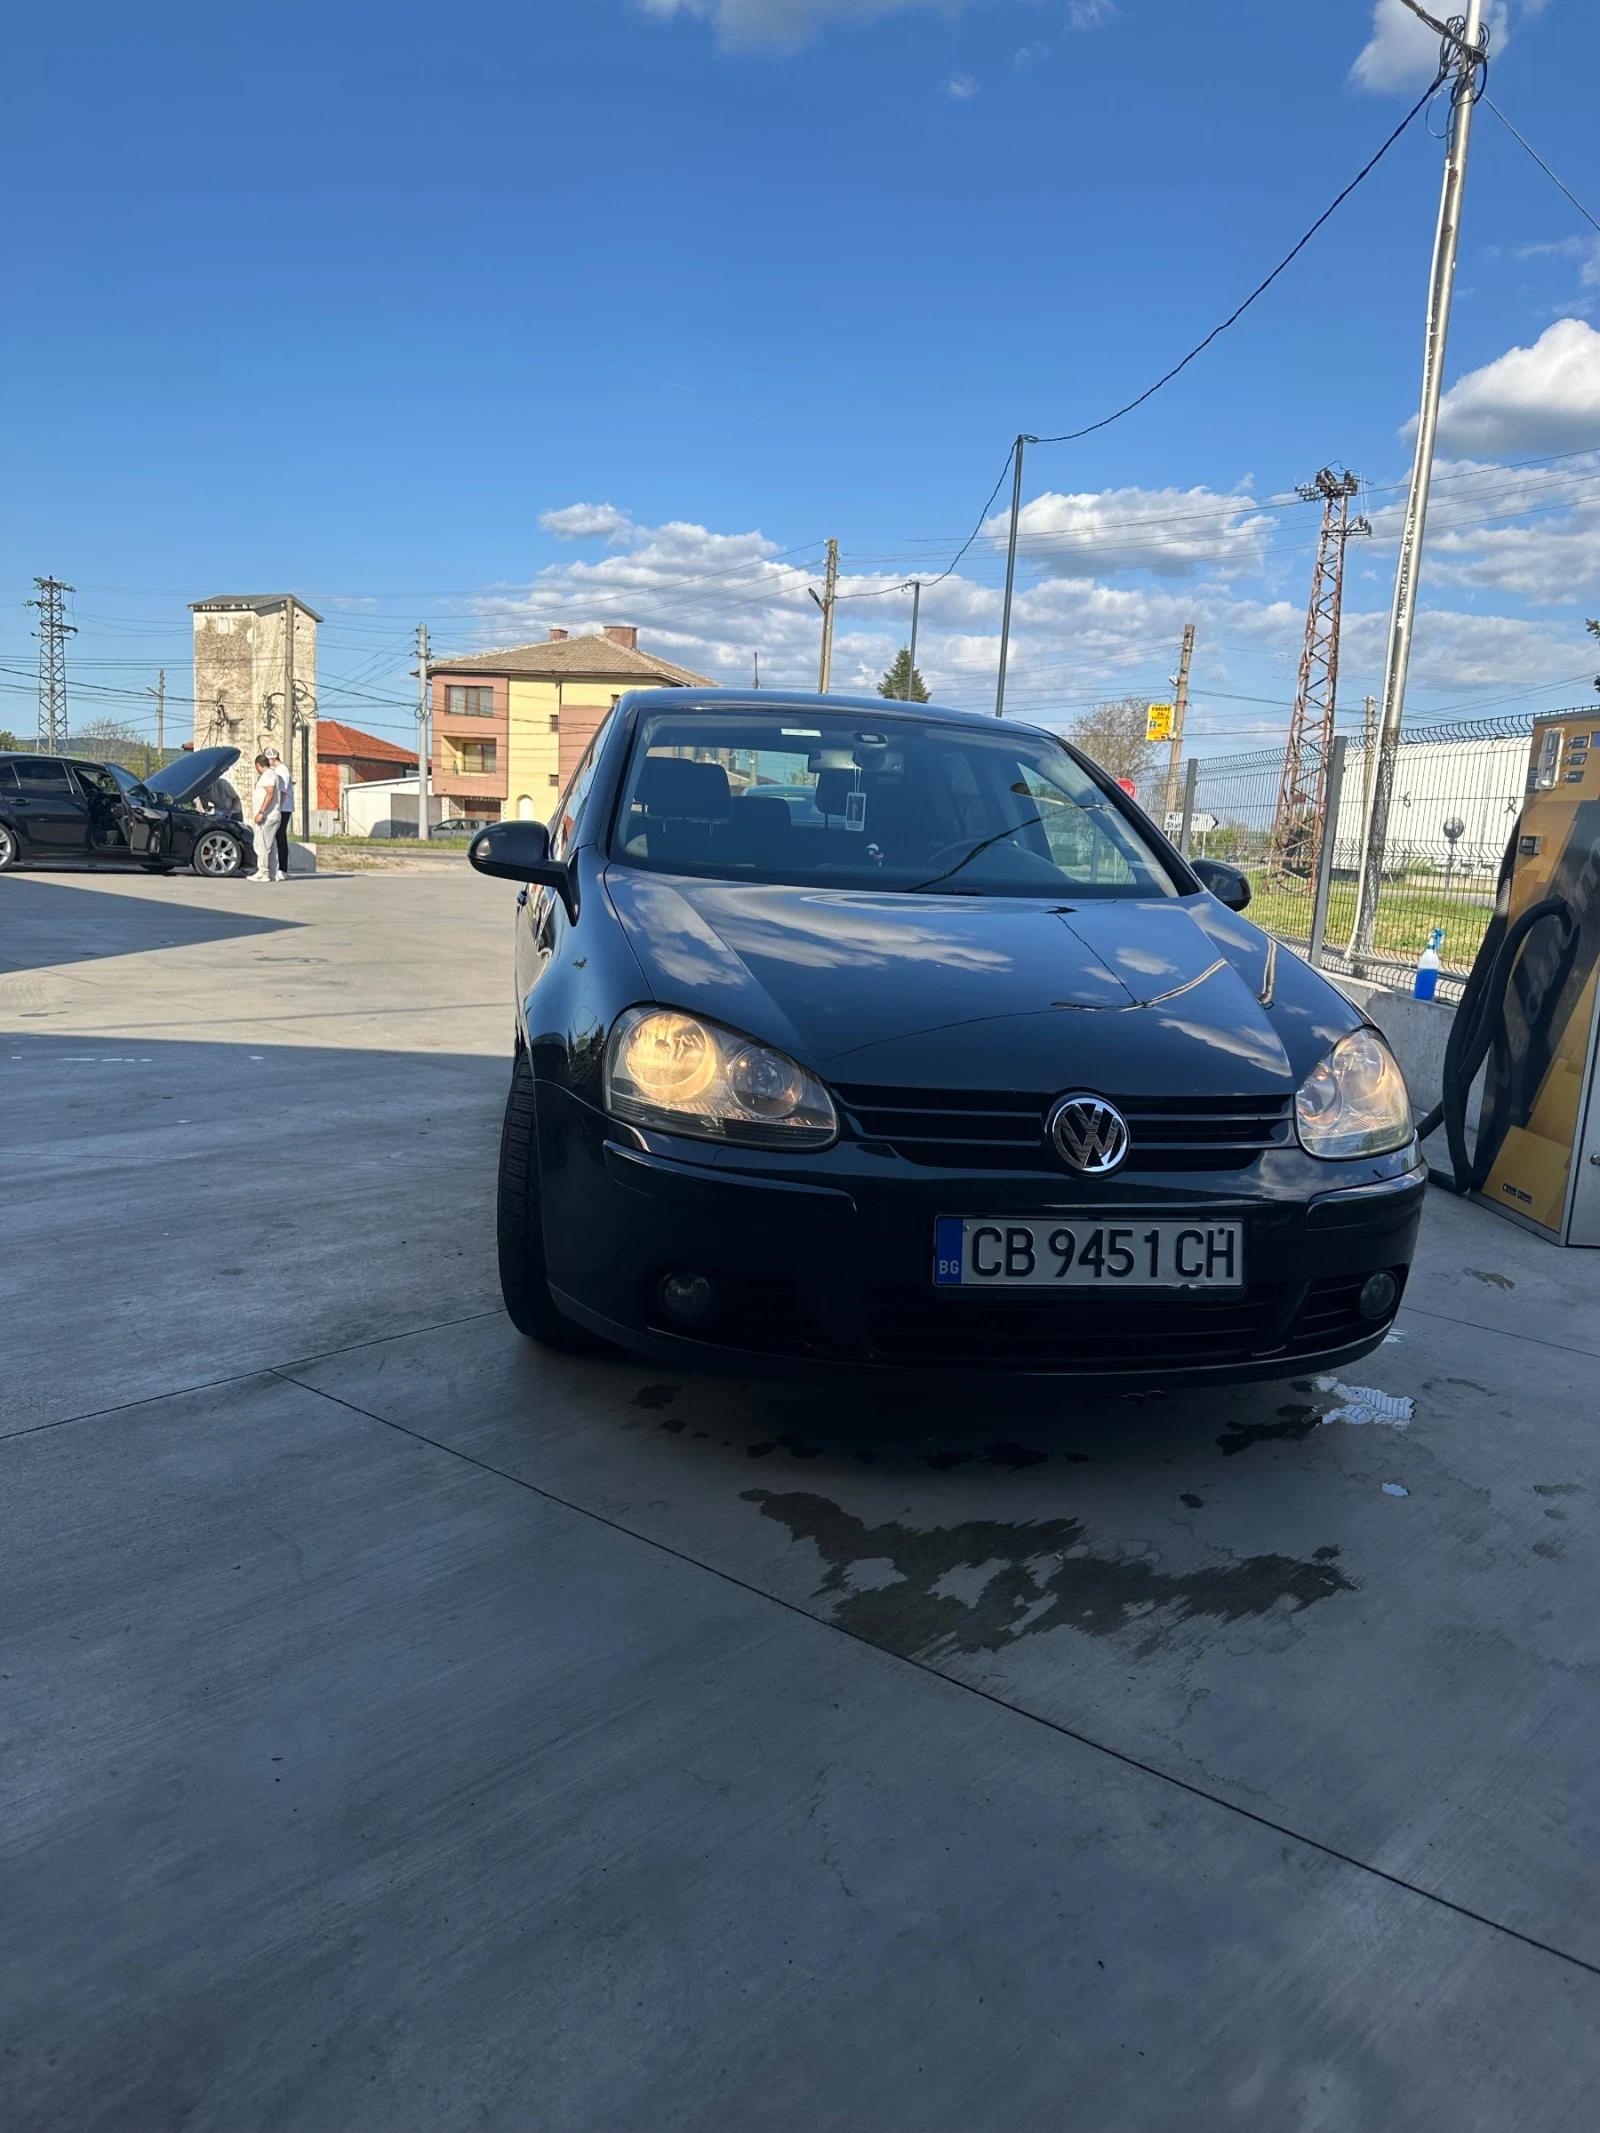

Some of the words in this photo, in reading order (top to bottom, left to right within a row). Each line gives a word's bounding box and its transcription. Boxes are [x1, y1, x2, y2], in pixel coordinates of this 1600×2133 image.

[939, 1259, 959, 1275] BG
[972, 1226, 1037, 1277] CB
[1048, 1227, 1159, 1278] 9451
[1175, 1229, 1235, 1278] CH
